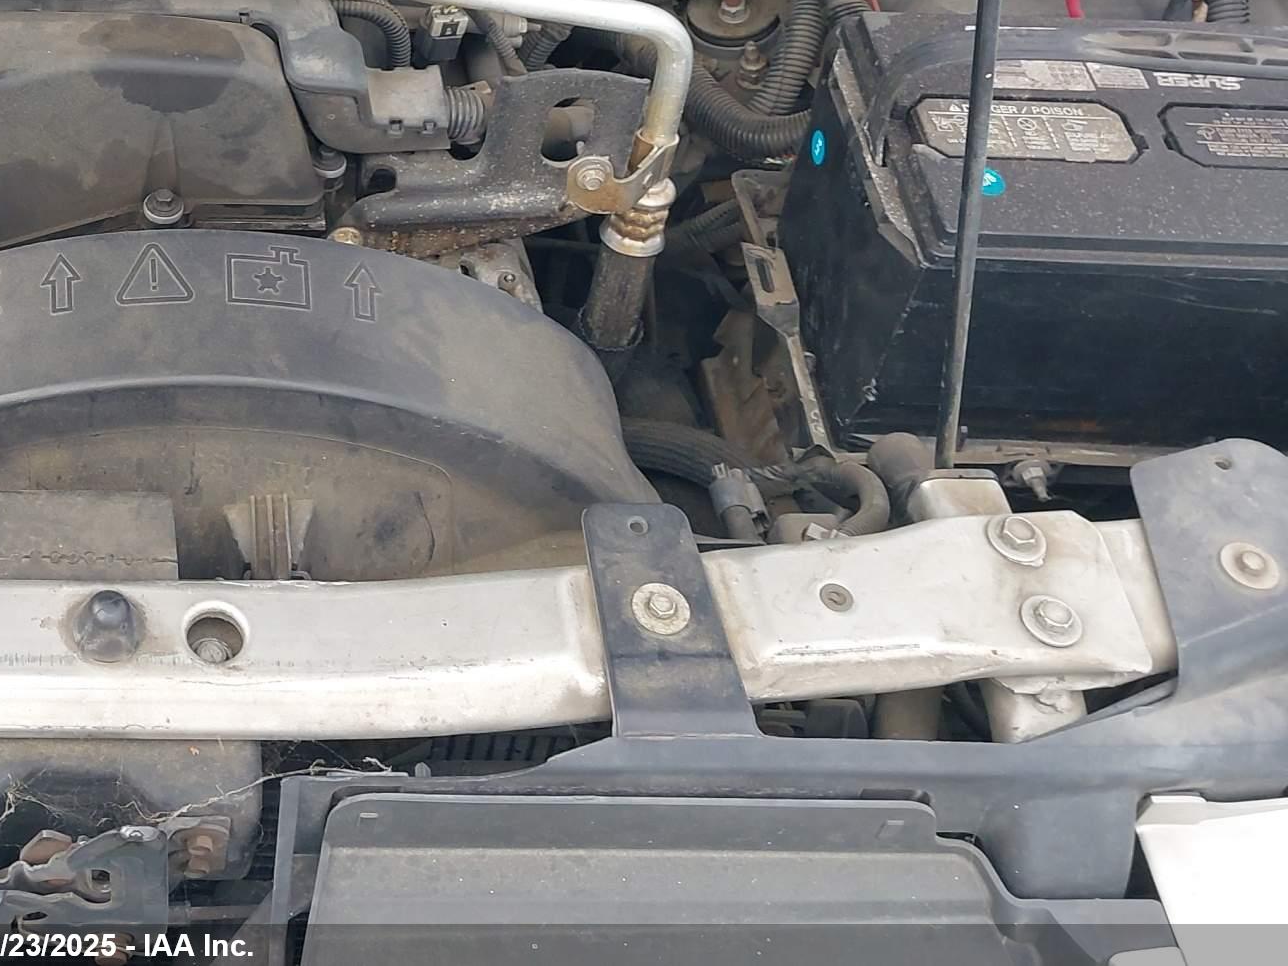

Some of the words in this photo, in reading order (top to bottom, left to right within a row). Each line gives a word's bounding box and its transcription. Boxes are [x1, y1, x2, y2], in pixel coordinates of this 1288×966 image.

[1153, 71, 1245, 91] SUPER
[961, 103, 1018, 114] DGER
[1031, 105, 1084, 116] POISON
